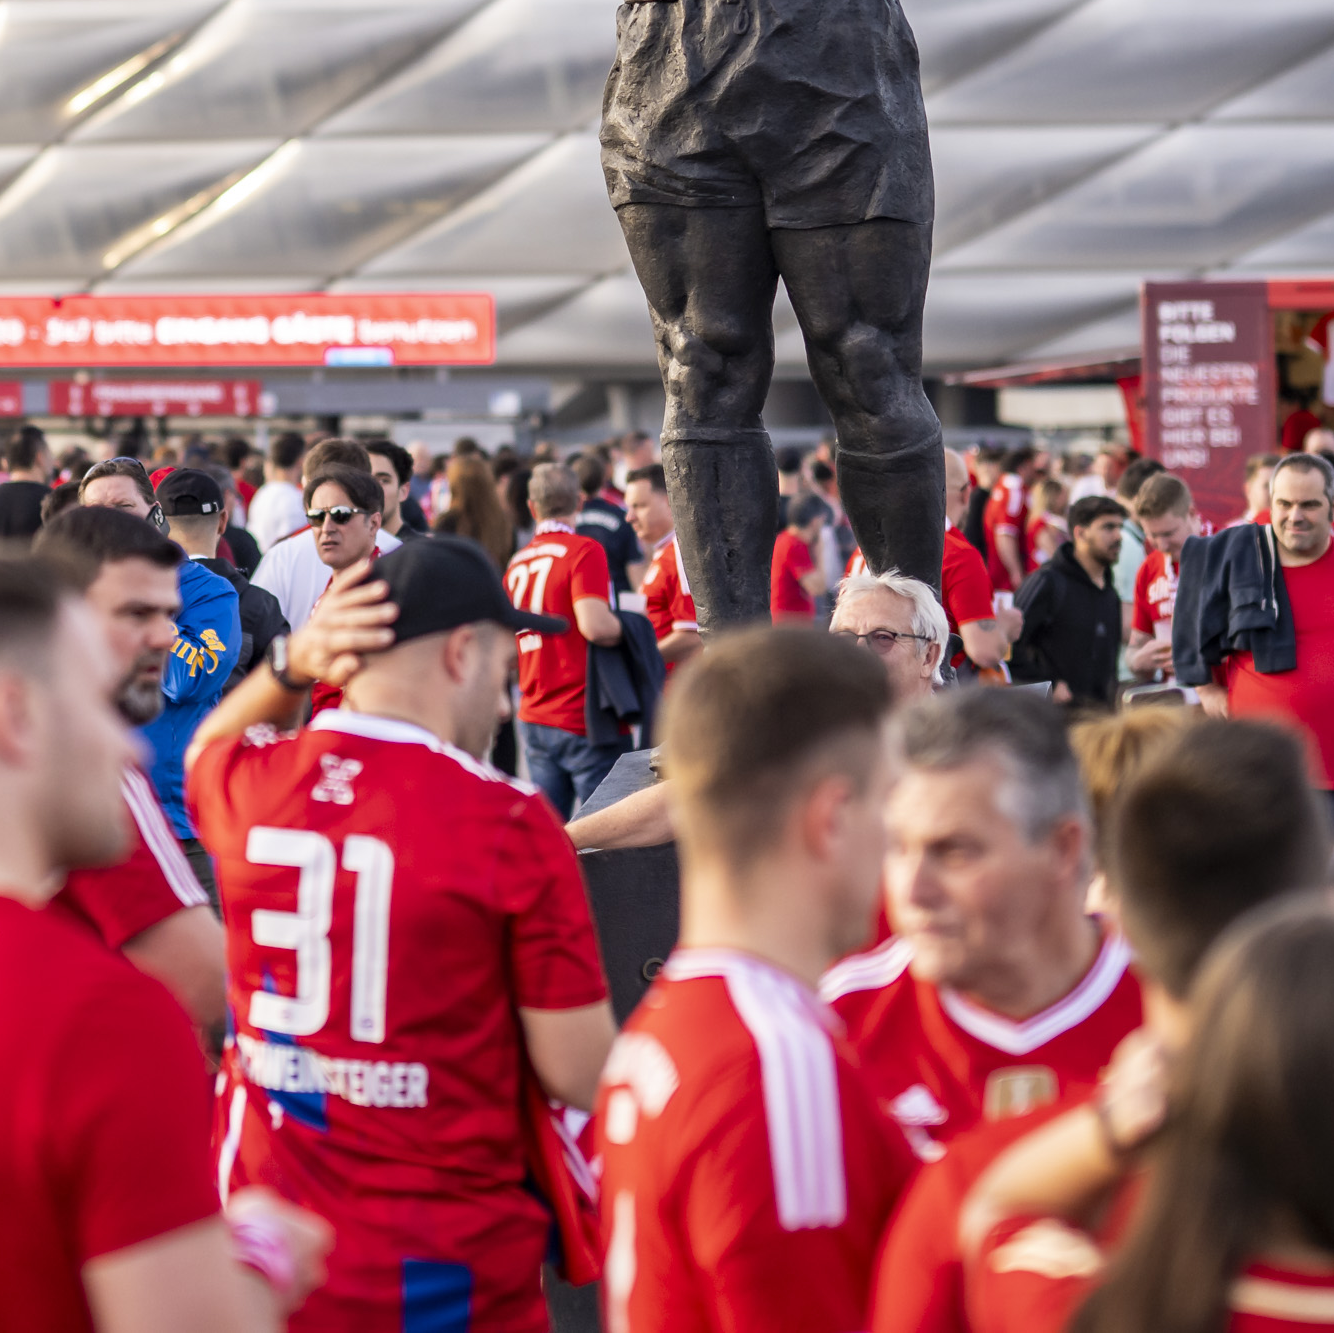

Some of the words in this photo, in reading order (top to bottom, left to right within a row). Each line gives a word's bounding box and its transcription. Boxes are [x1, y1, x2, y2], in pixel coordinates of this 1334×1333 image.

[1158, 301, 1213, 321] BITTE
[1158, 321, 1236, 343] FOLGEN
[1160, 344, 1190, 365] DIE
[1160, 364, 1257, 385] NEUESTEN
[1160, 385, 1258, 405] PRODUKTE
[1161, 407, 1204, 427] GIBT
[1205, 406, 1234, 426] ES
[1161, 427, 1206, 446] HIER
[1208, 426, 1241, 447] BEI
[1161, 447, 1209, 469] UNS!
[245, 825, 395, 1043] 31
